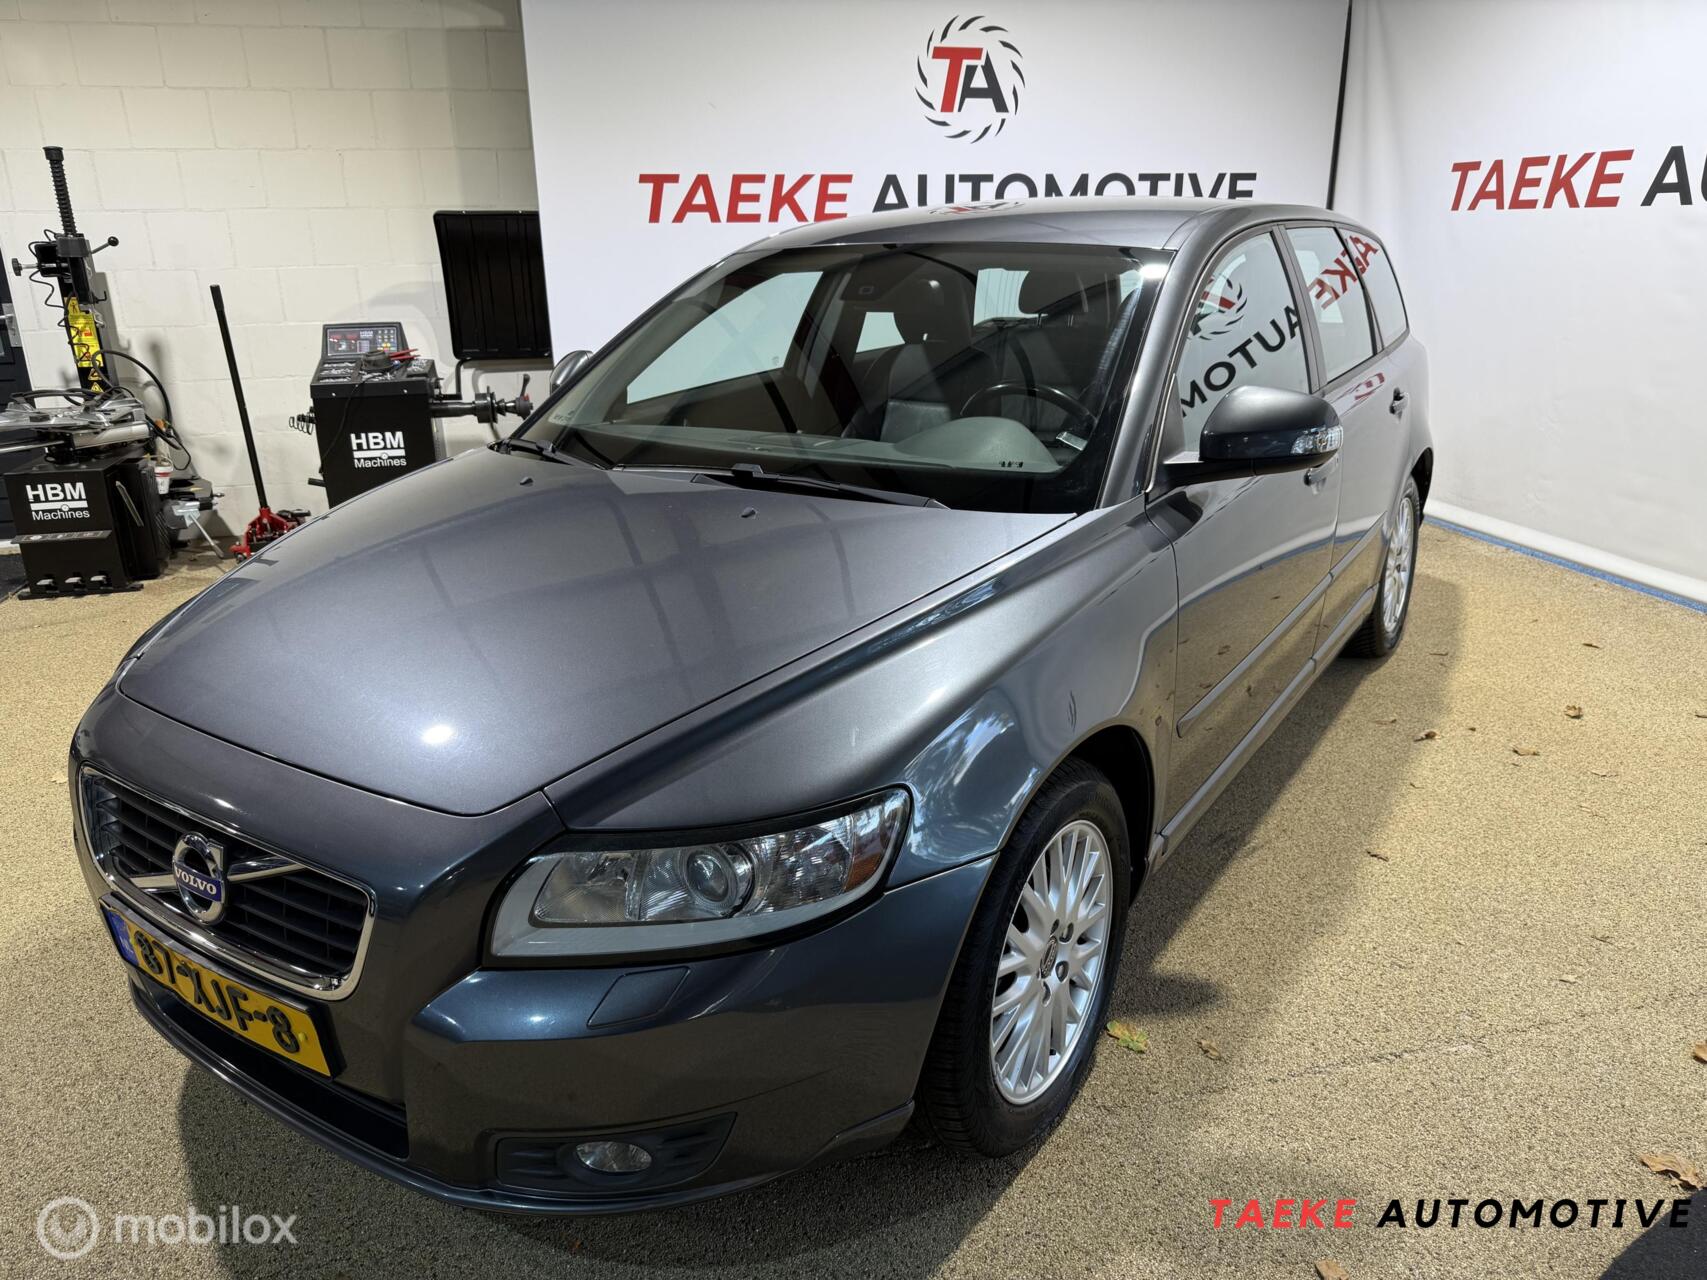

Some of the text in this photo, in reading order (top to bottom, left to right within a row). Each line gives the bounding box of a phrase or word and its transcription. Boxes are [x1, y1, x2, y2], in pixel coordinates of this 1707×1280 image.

[931, 46, 1009, 113] TA
[1450, 145, 1707, 211] TAEKE A
[638, 174, 853, 223] TAEKE
[350, 431, 405, 450] HBM
[353, 457, 407, 468] Machines
[25, 482, 87, 502] HBM
[31, 508, 91, 521] Machines
[174, 866, 217, 895] VOLVO
